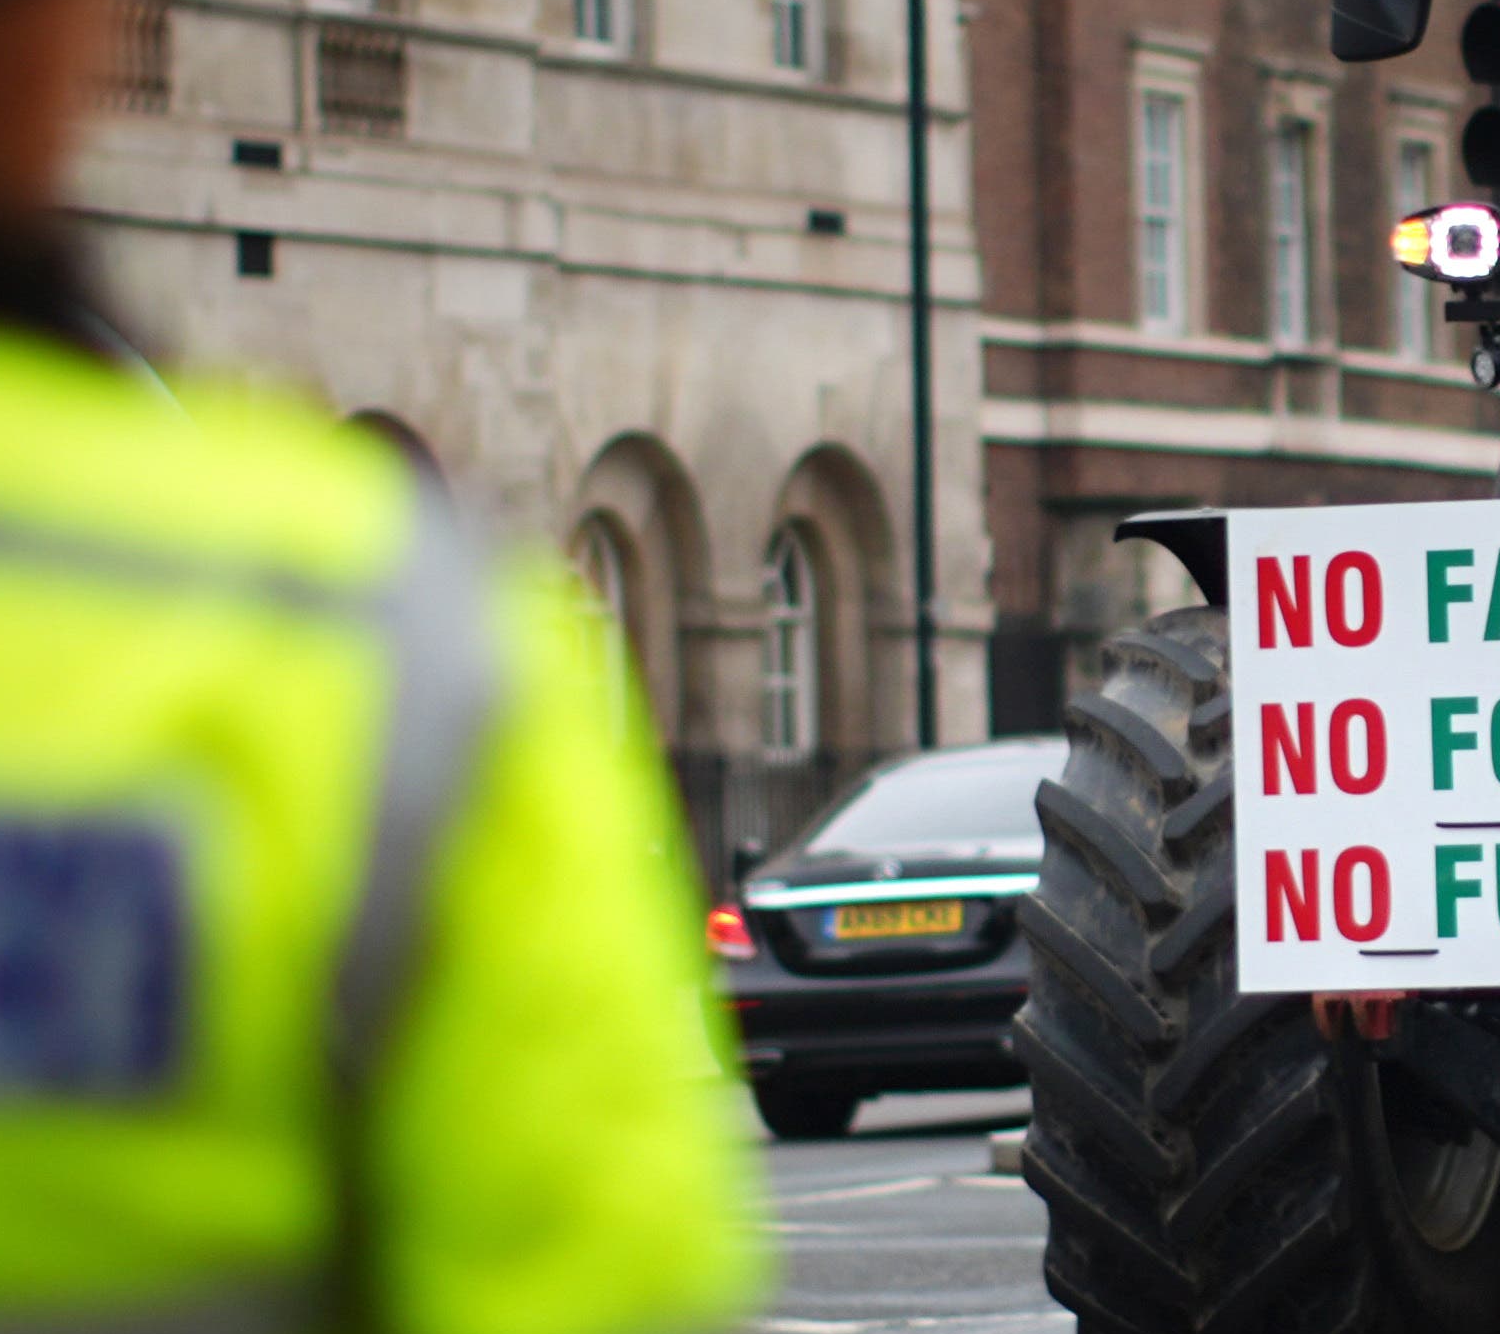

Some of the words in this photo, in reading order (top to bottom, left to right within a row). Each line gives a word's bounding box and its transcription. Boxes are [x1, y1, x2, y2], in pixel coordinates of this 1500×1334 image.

[1256, 550, 1384, 650] NO
[1260, 697, 1388, 796] NO
[1264, 844, 1392, 943] NO
